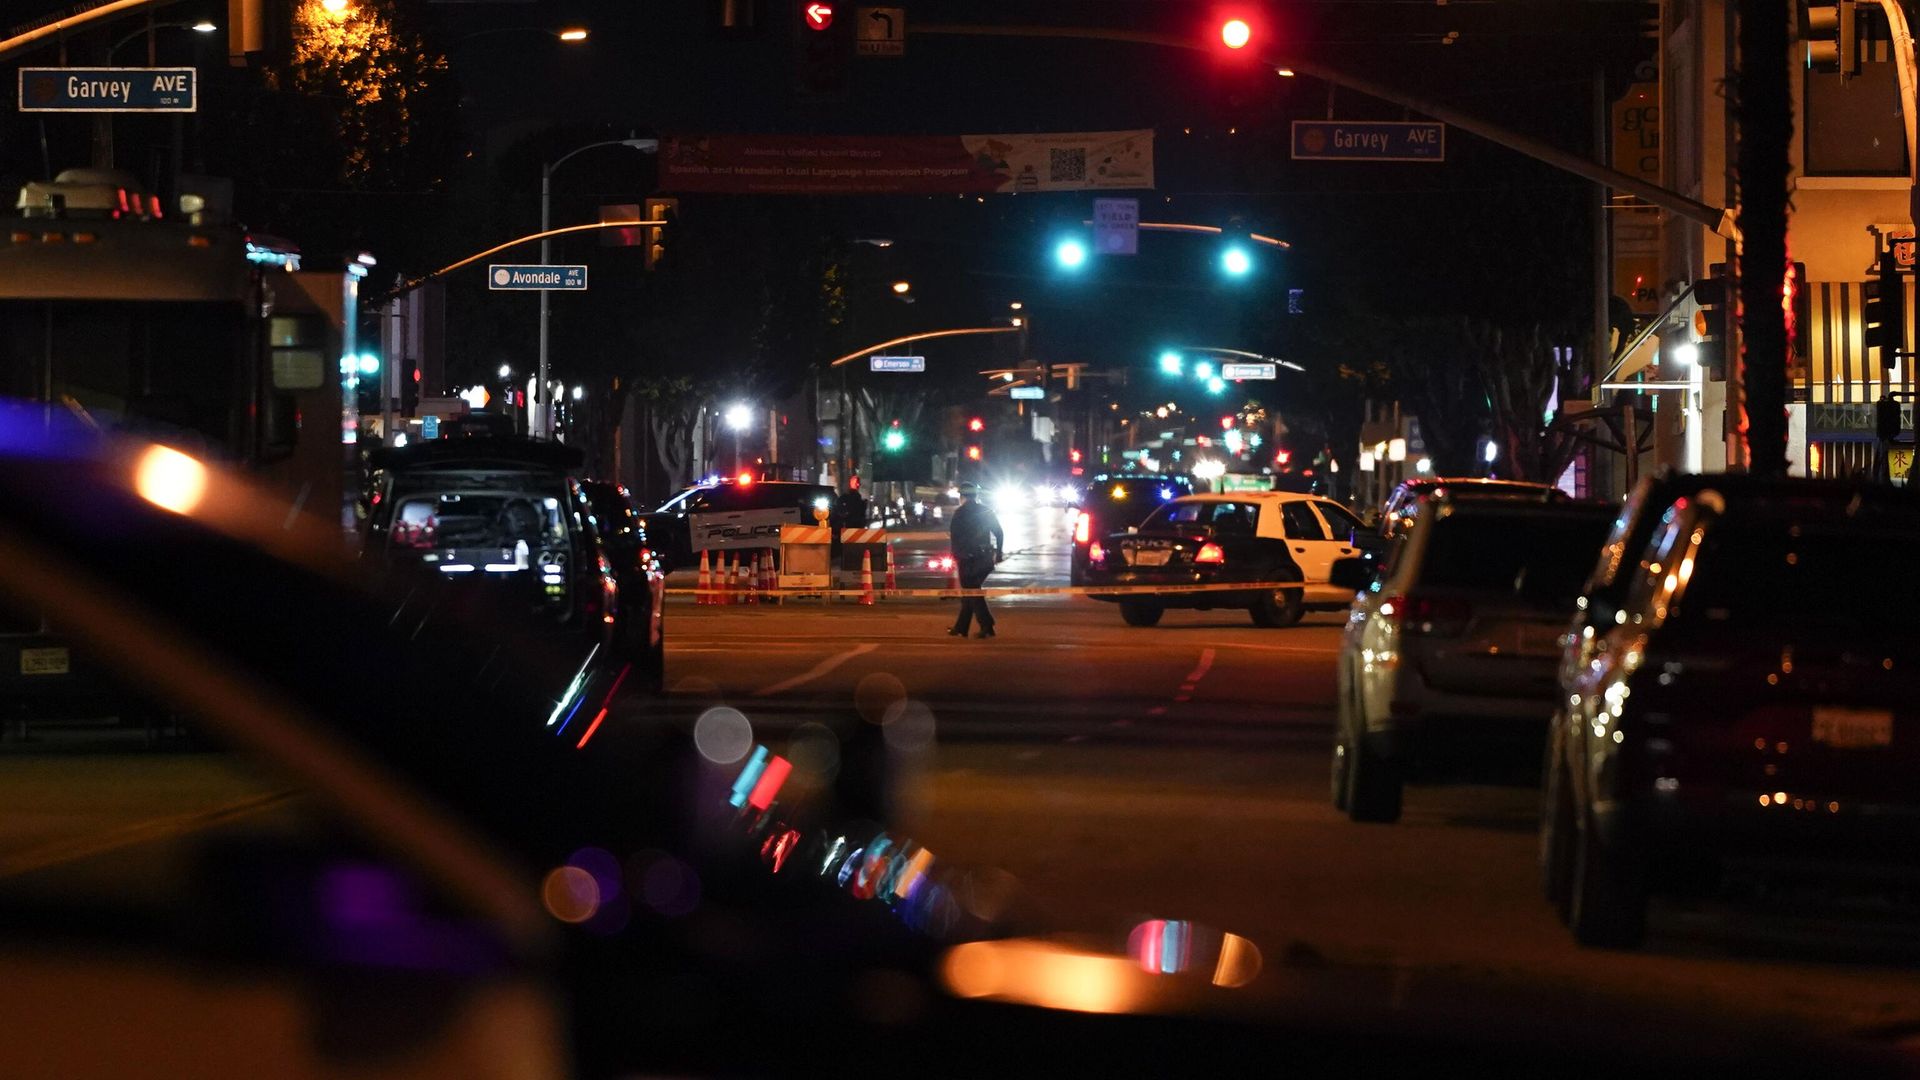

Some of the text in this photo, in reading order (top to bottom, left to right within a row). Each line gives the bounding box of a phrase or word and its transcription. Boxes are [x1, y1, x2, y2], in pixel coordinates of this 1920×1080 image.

[67, 75, 188, 103] Garvey AVE
[1334, 128, 1437, 152] Garvey AVE
[669, 165, 969, 178] Spanish and Mandarin Dual Language Immersion Program
[512, 269, 579, 284] Avondale AVE
[707, 525, 781, 540] POLICE
